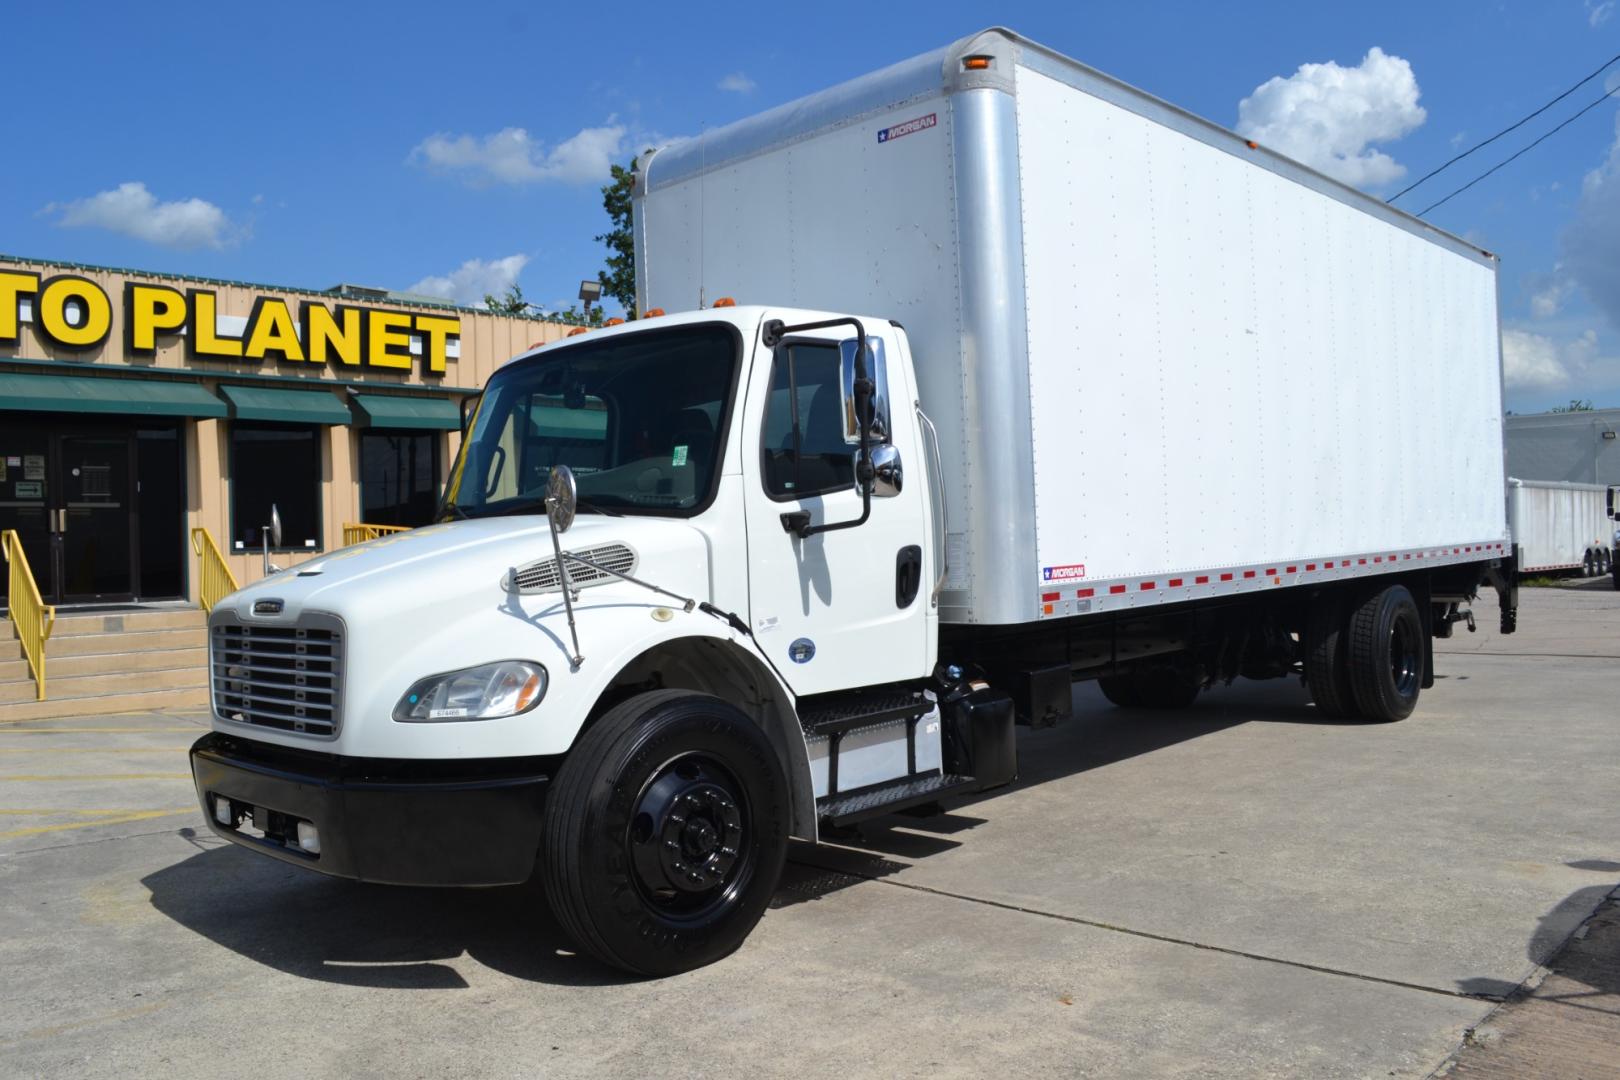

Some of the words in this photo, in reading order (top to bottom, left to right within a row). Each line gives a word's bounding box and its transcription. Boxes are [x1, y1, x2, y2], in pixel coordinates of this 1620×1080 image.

[888, 117, 935, 138] MORGAN
[0, 274, 111, 345] TO
[133, 286, 460, 372] PLANET
[1052, 567, 1083, 578] MORGAN
